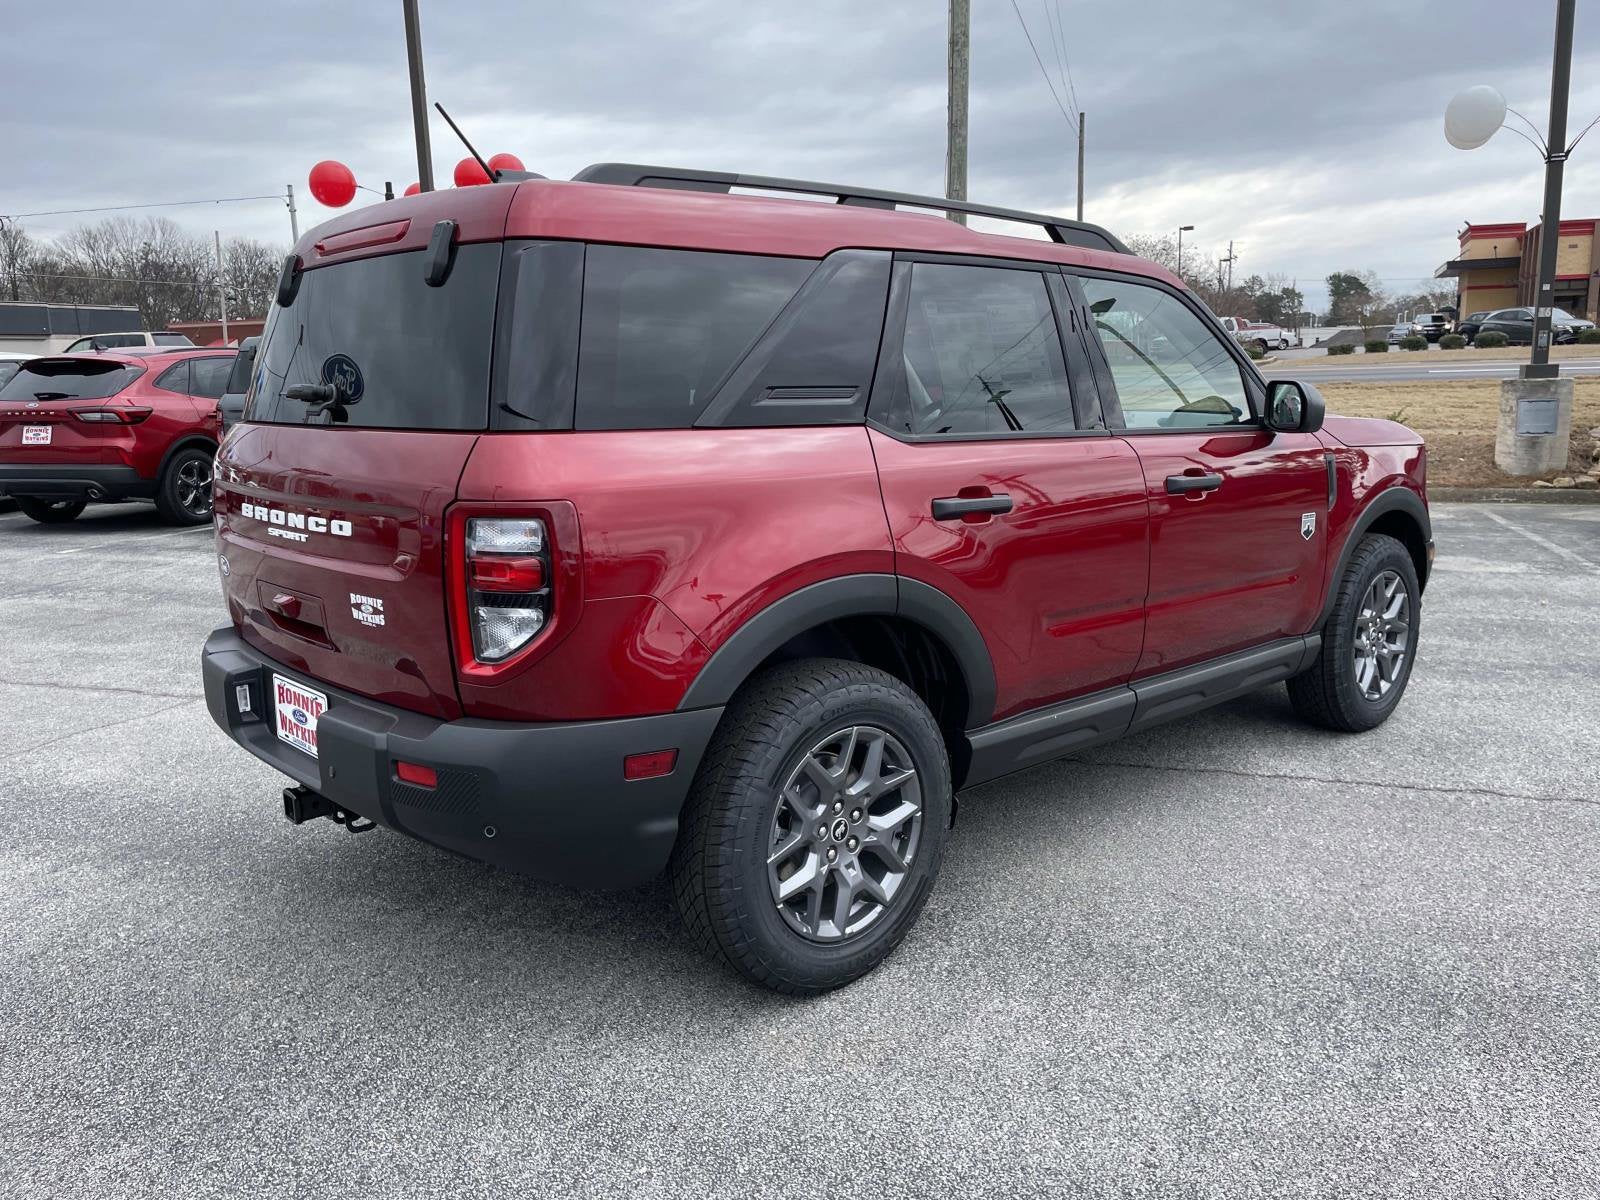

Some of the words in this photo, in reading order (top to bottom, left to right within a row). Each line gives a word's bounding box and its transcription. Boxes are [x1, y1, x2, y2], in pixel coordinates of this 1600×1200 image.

[241, 503, 352, 536] BRONCO
[268, 527, 309, 542] SPORT
[350, 592, 384, 612] RONNIE
[351, 607, 385, 626] WATKINS
[277, 683, 323, 718] RONNIE
[279, 708, 318, 747] WATKIN
